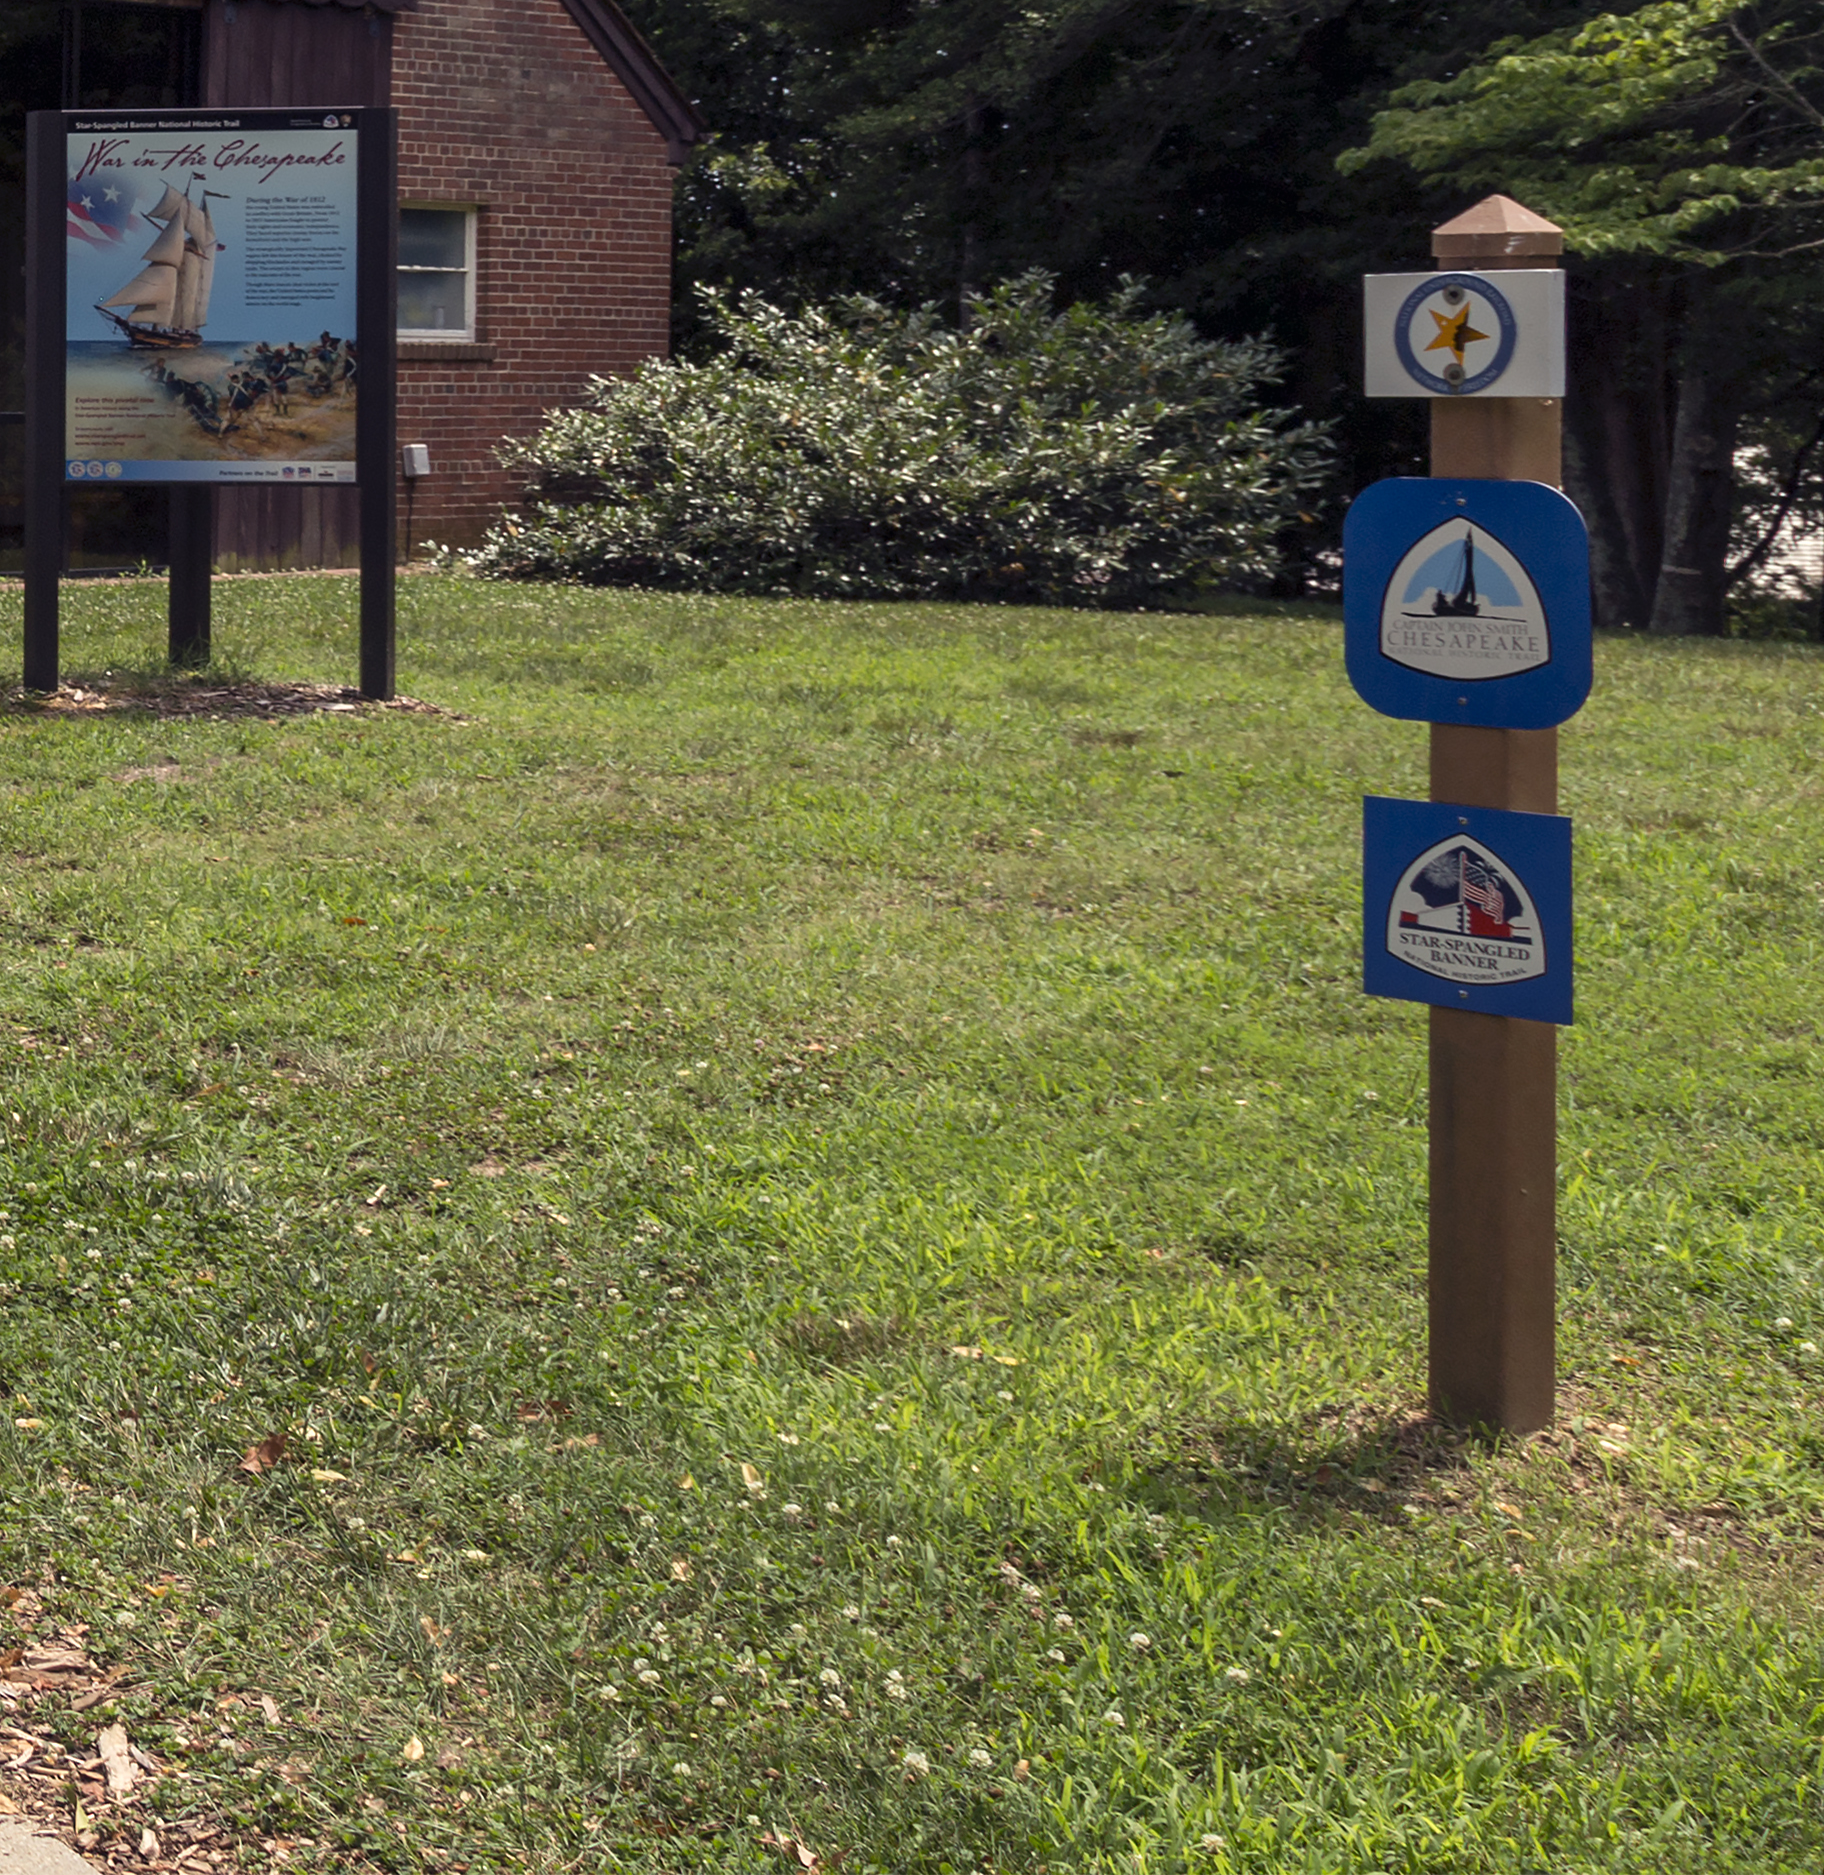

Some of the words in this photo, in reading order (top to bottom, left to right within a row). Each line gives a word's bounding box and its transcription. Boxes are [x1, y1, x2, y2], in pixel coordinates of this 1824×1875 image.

[75, 121, 128, 130] Star-Spangled
[130, 121, 157, 129] Banner
[158, 120, 191, 128] National
[223, 119, 240, 127] Trail
[75, 139, 130, 182] War
[132, 149, 160, 167] in
[151, 143, 208, 171] the
[213, 139, 346, 184] Chesapeake
[1393, 619, 1443, 633] CAPTAIN
[1447, 620, 1482, 633] JOHN
[1485, 622, 1529, 635] SMITH
[1386, 630, 1541, 653] CHESAPEAKE
[1388, 646, 1444, 657] NATIONAL
[1449, 649, 1501, 660] HISTORIC
[1509, 651, 1541, 662] TRAIL
[1399, 932, 1531, 961] STAR-SPANGLED
[1403, 950, 1449, 976] NATIONAL
[1451, 971, 1497, 981] HISTORIC
[1500, 967, 1527, 978] TRAIL
[1429, 949, 1500, 971] BANNER
